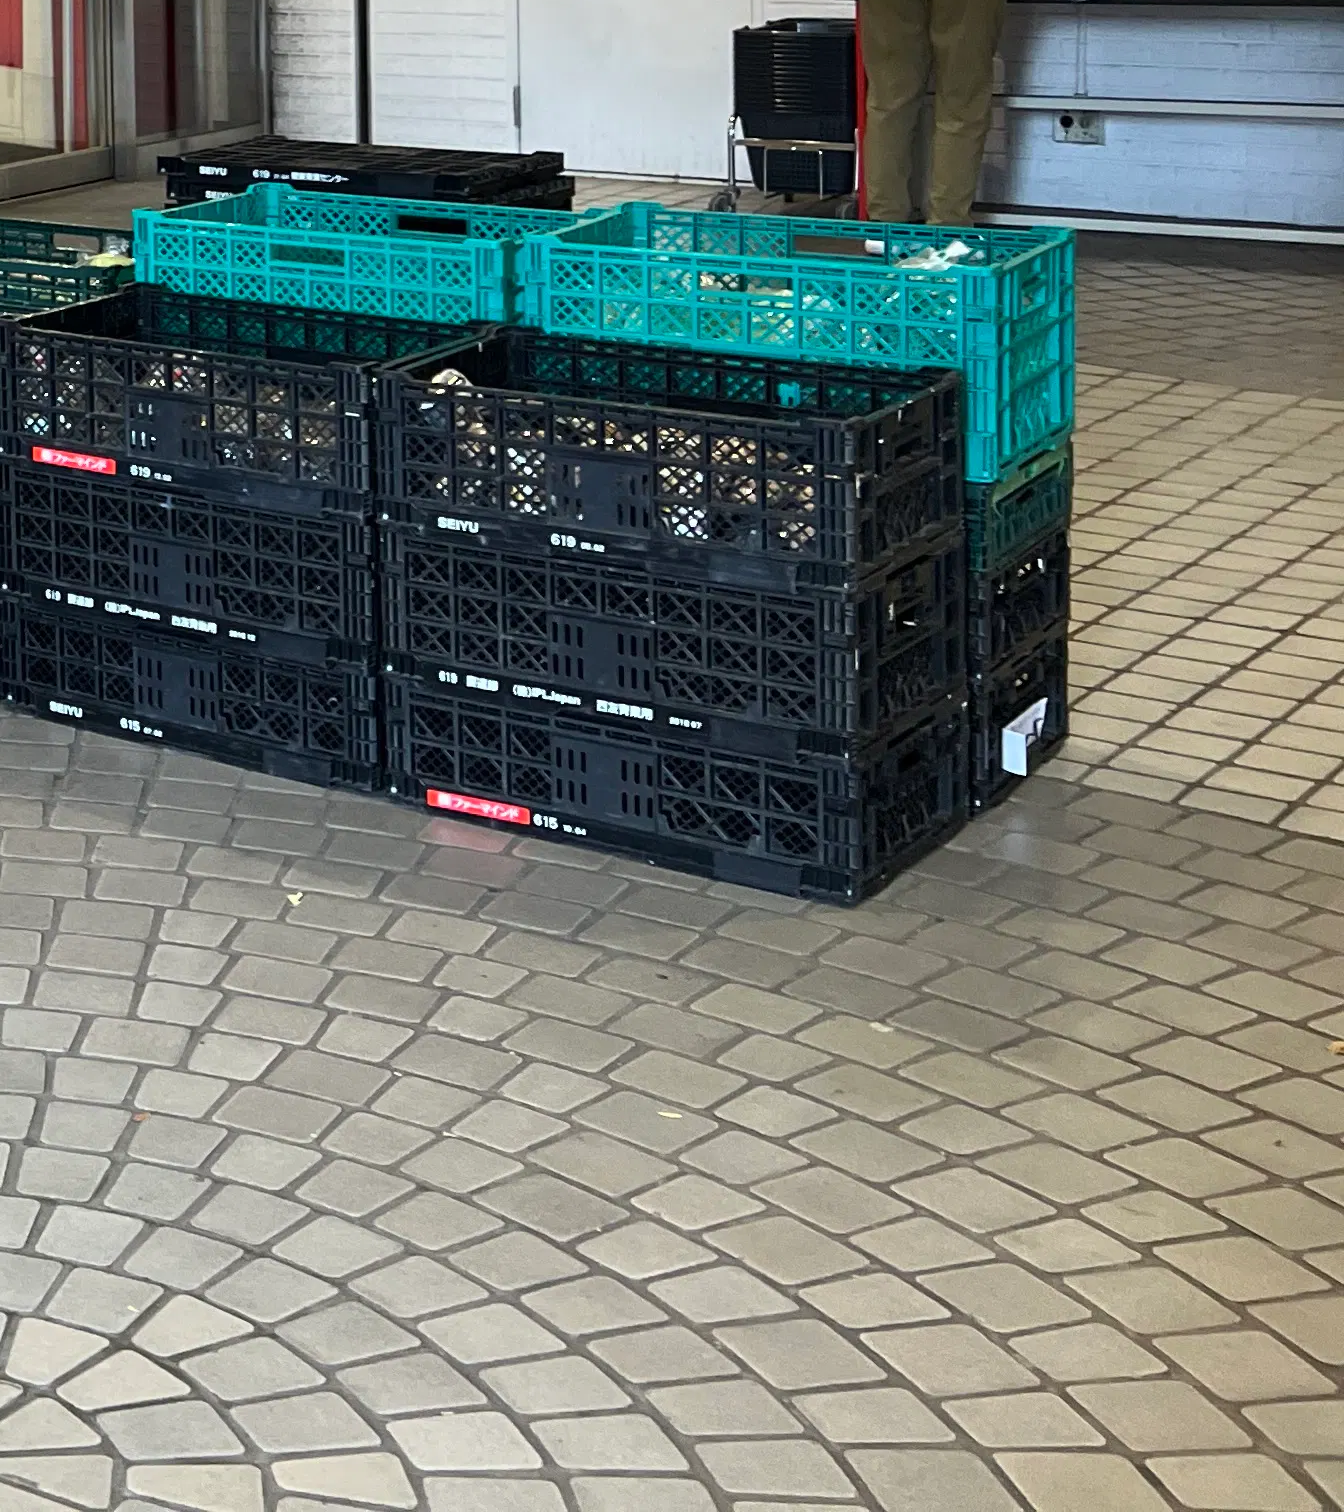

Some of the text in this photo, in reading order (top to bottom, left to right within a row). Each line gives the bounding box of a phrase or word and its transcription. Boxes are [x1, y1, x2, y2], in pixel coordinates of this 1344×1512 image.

[199, 165, 228, 176] SEIYU
[130, 464, 151, 478] 619
[437, 516, 577, 548] SEIYU 619
[49, 700, 141, 733] SEIYU 615
[532, 812, 560, 830] 615
